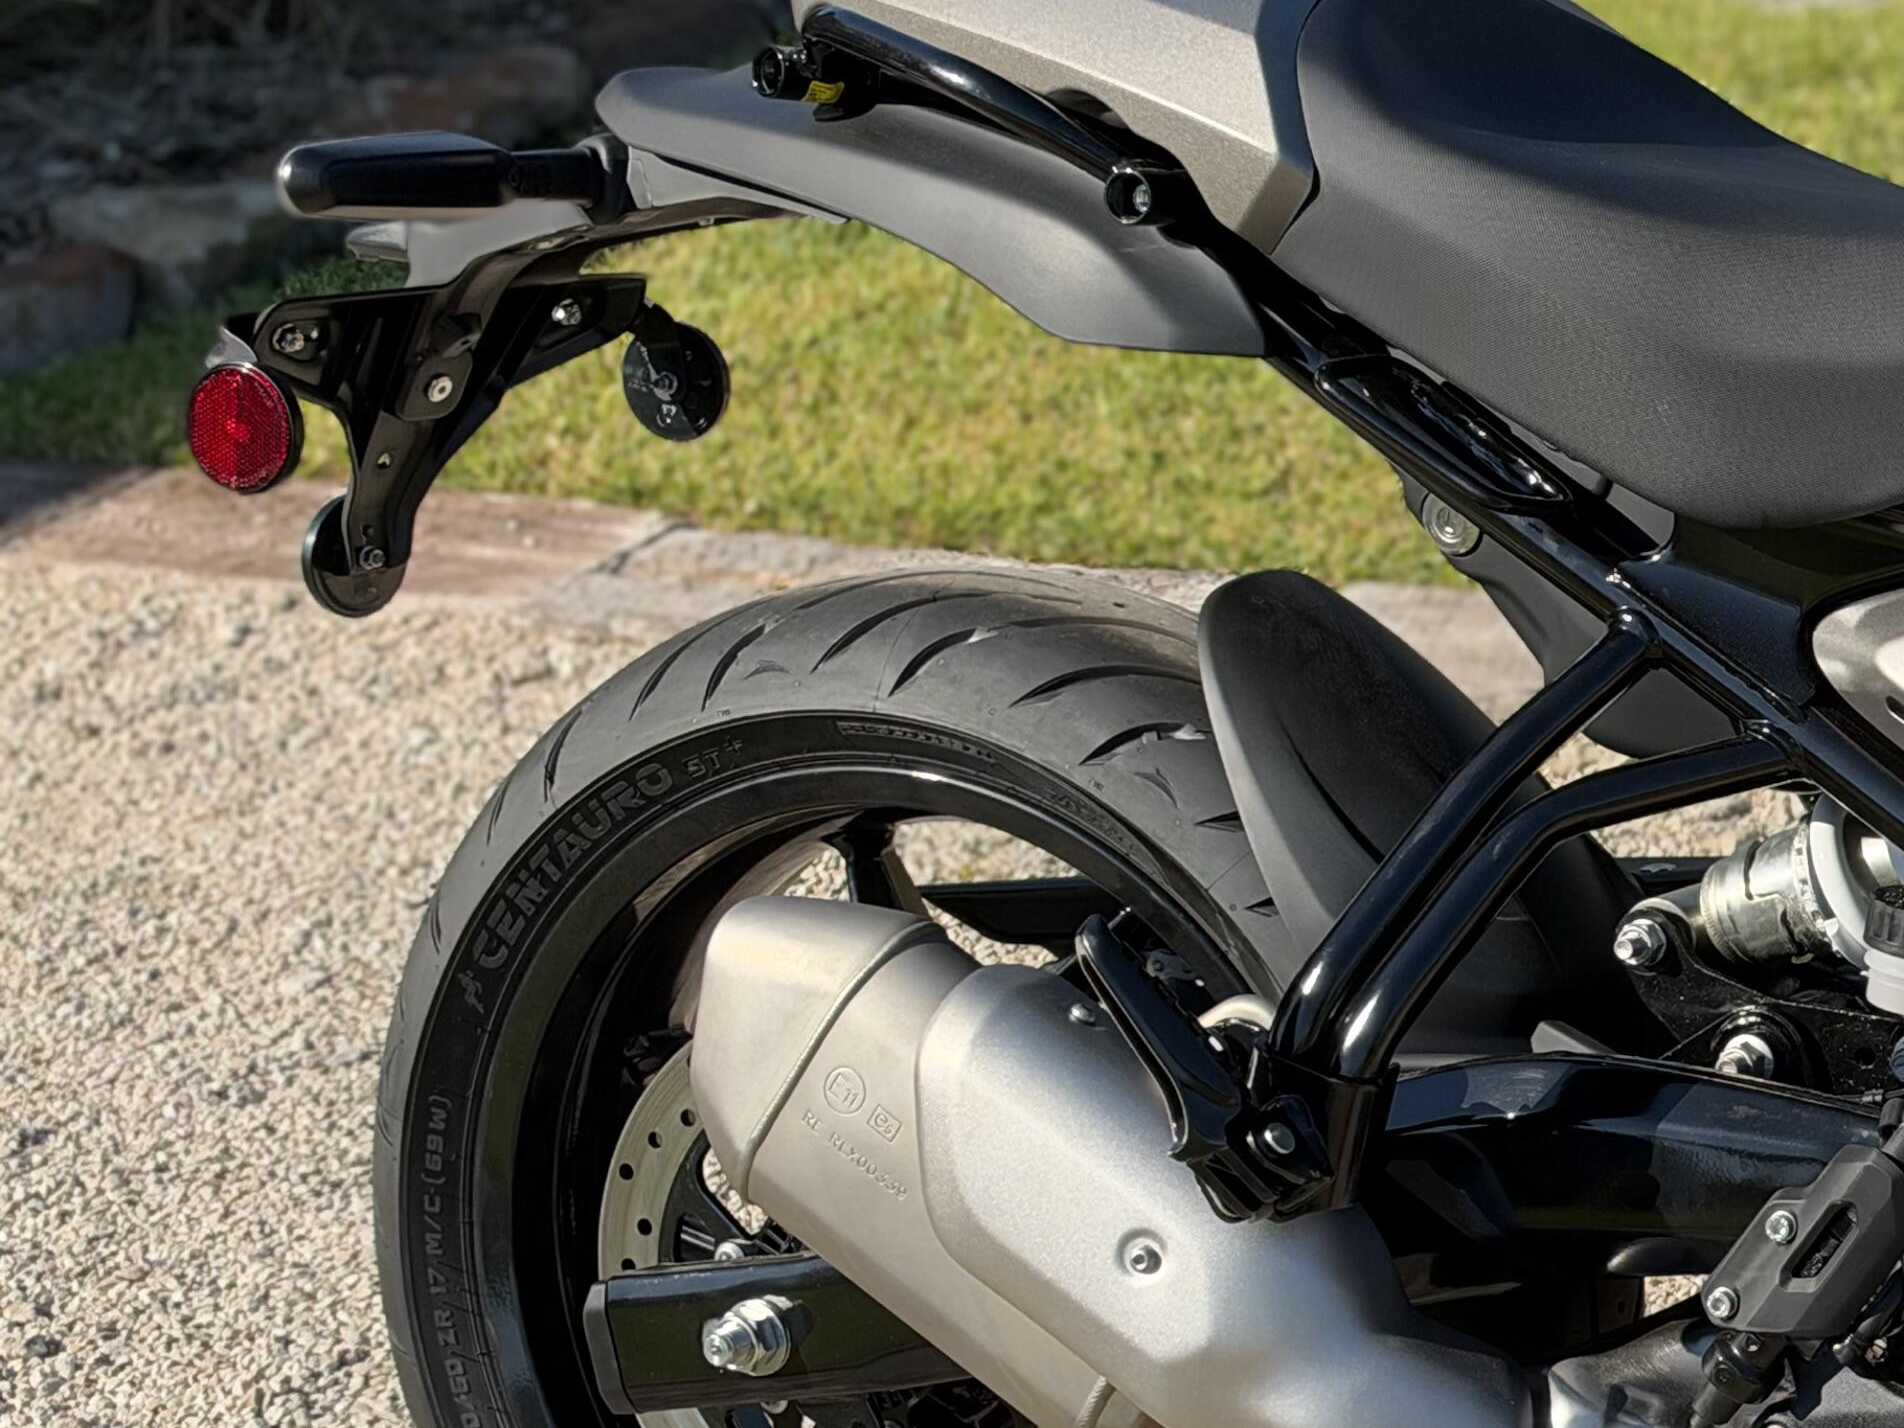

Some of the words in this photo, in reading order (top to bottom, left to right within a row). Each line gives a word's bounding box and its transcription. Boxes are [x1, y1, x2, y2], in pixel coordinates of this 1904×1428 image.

[472, 762, 674, 969] CENTAURO
[426, 1266, 449, 1299] 17
[434, 1309, 462, 1355] ZR
